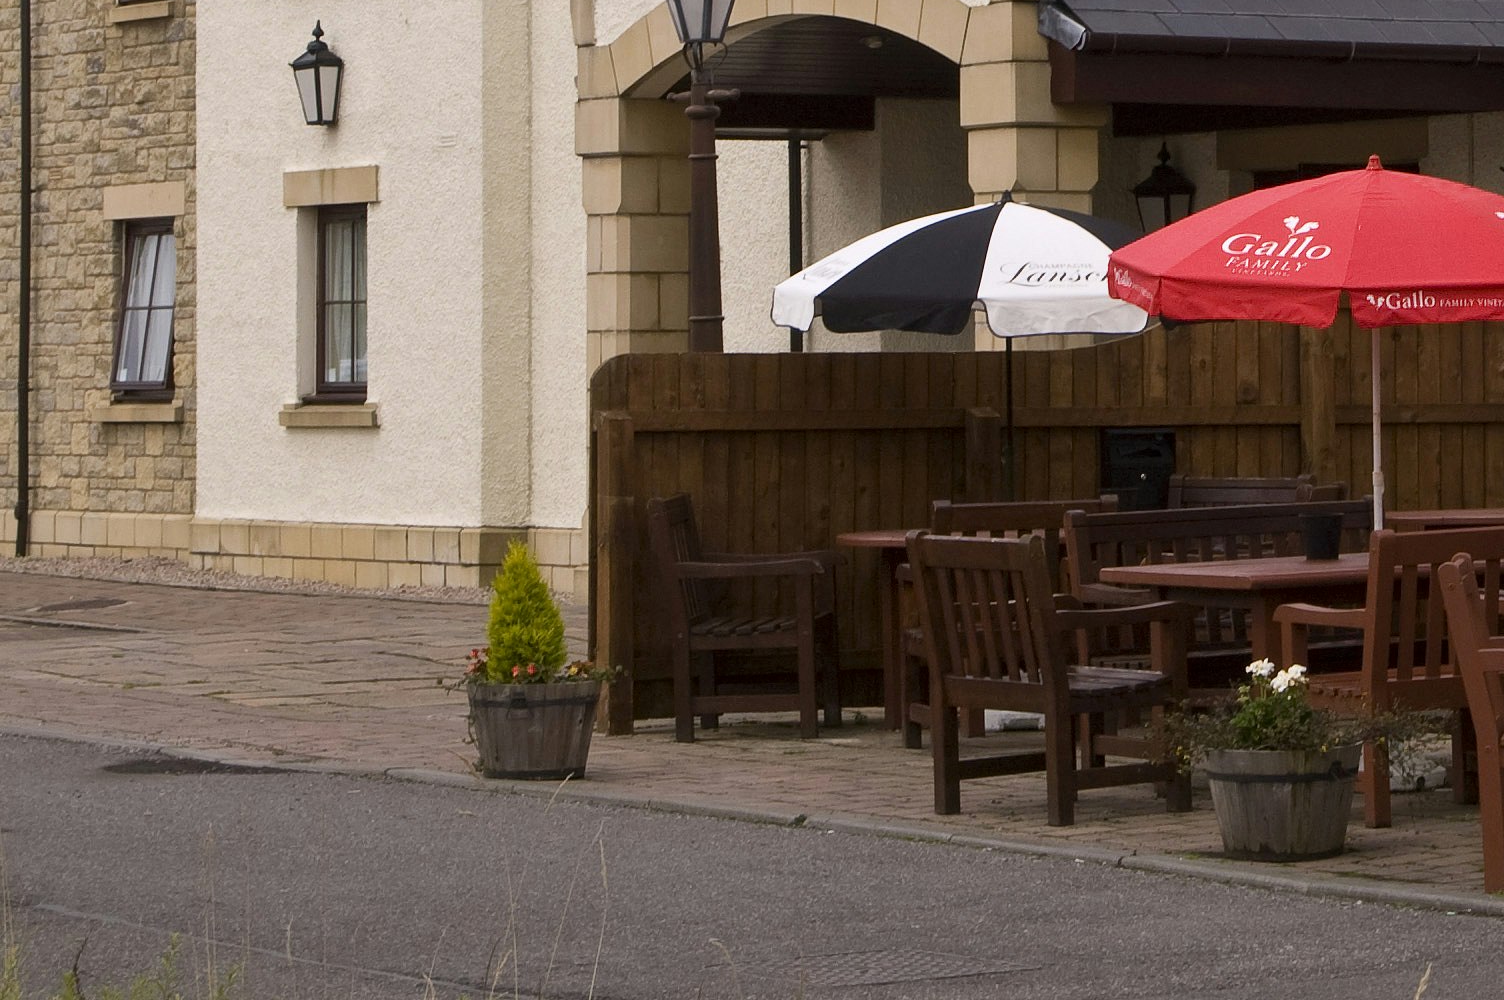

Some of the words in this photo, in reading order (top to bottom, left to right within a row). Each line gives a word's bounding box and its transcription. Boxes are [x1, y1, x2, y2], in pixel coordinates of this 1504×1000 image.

[1221, 233, 1332, 260] Gallo
[1225, 256, 1308, 272] FAMILY
[1385, 290, 1436, 310] Gallo
[1440, 299, 1474, 308] FAMILY
